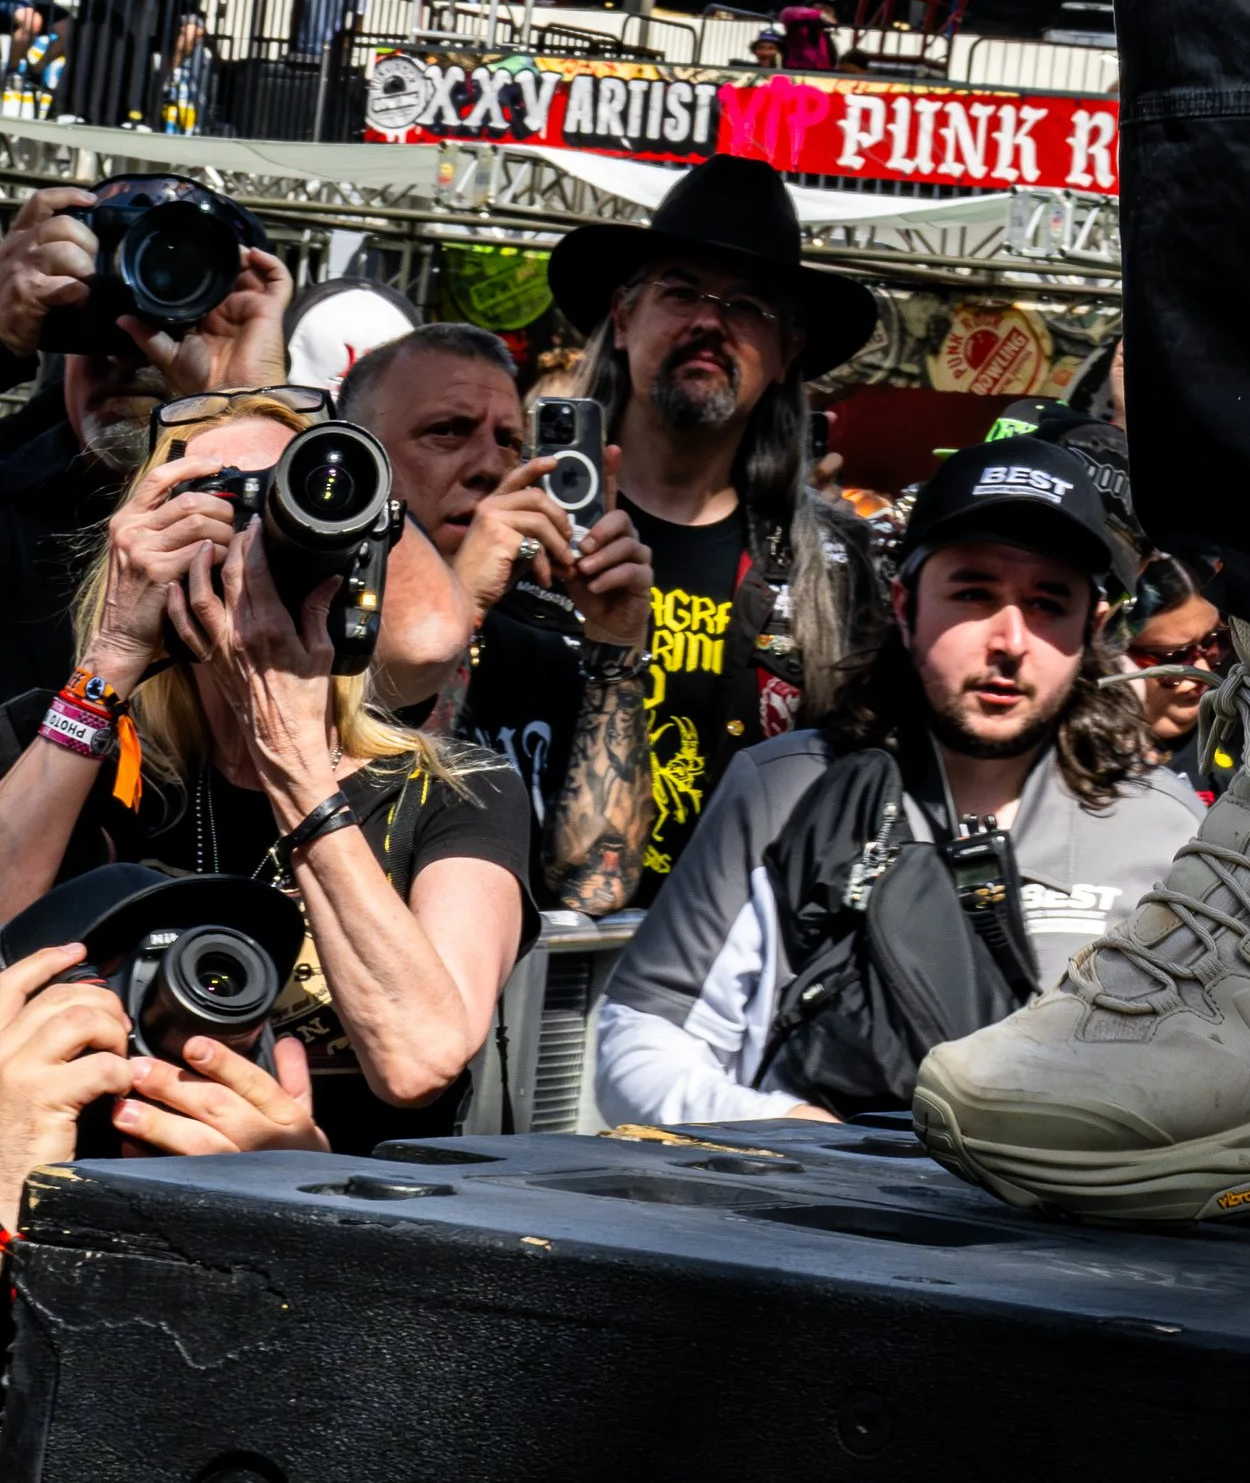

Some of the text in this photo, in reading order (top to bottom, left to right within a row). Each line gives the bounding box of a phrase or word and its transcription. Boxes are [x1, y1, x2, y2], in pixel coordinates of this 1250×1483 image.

[416, 65, 562, 136] XXV
[564, 74, 717, 142] ARTIST
[836, 93, 1048, 183] PUNK
[979, 466, 1074, 496] BEST
[48, 714, 87, 739] PHOTO
[1020, 883, 1123, 910] BEST
[150, 932, 179, 945] Nik
